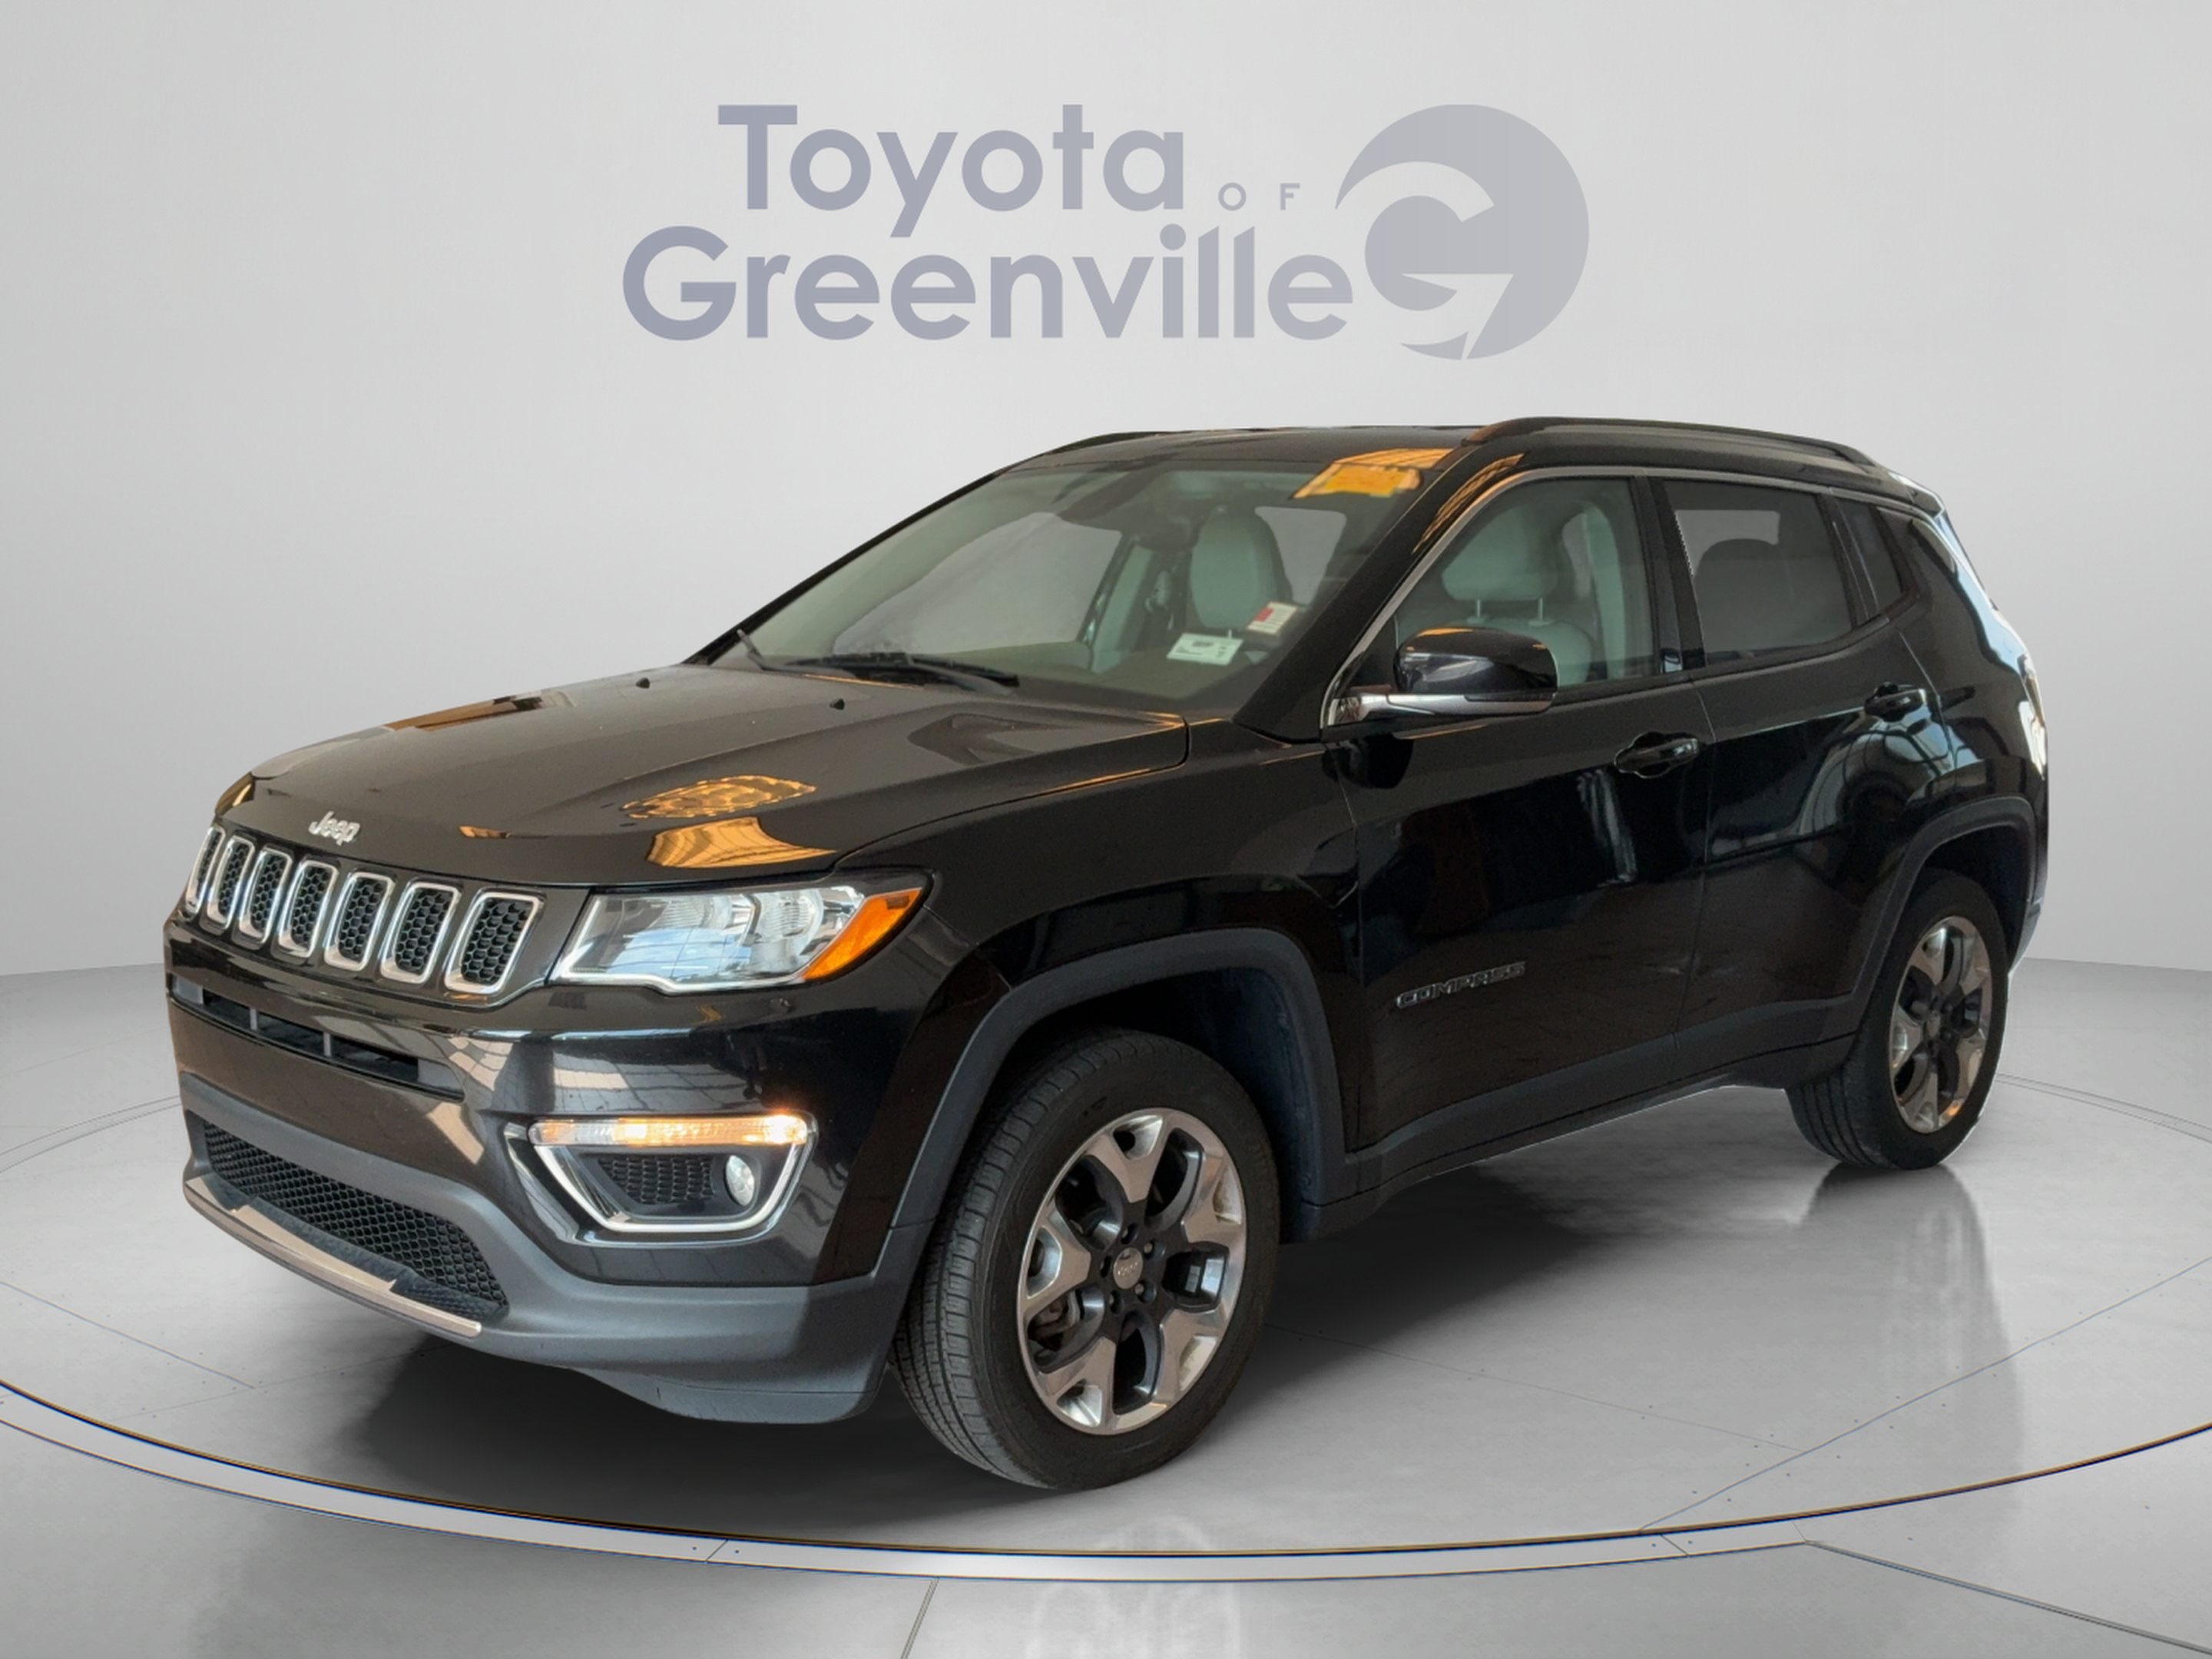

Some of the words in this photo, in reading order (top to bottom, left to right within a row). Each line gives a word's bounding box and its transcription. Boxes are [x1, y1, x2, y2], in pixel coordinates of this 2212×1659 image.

[717, 104, 1184, 237] Toyota
[1218, 183, 1300, 210] OF
[623, 224, 1353, 341] Greenville
[308, 810, 361, 846] Jeep
